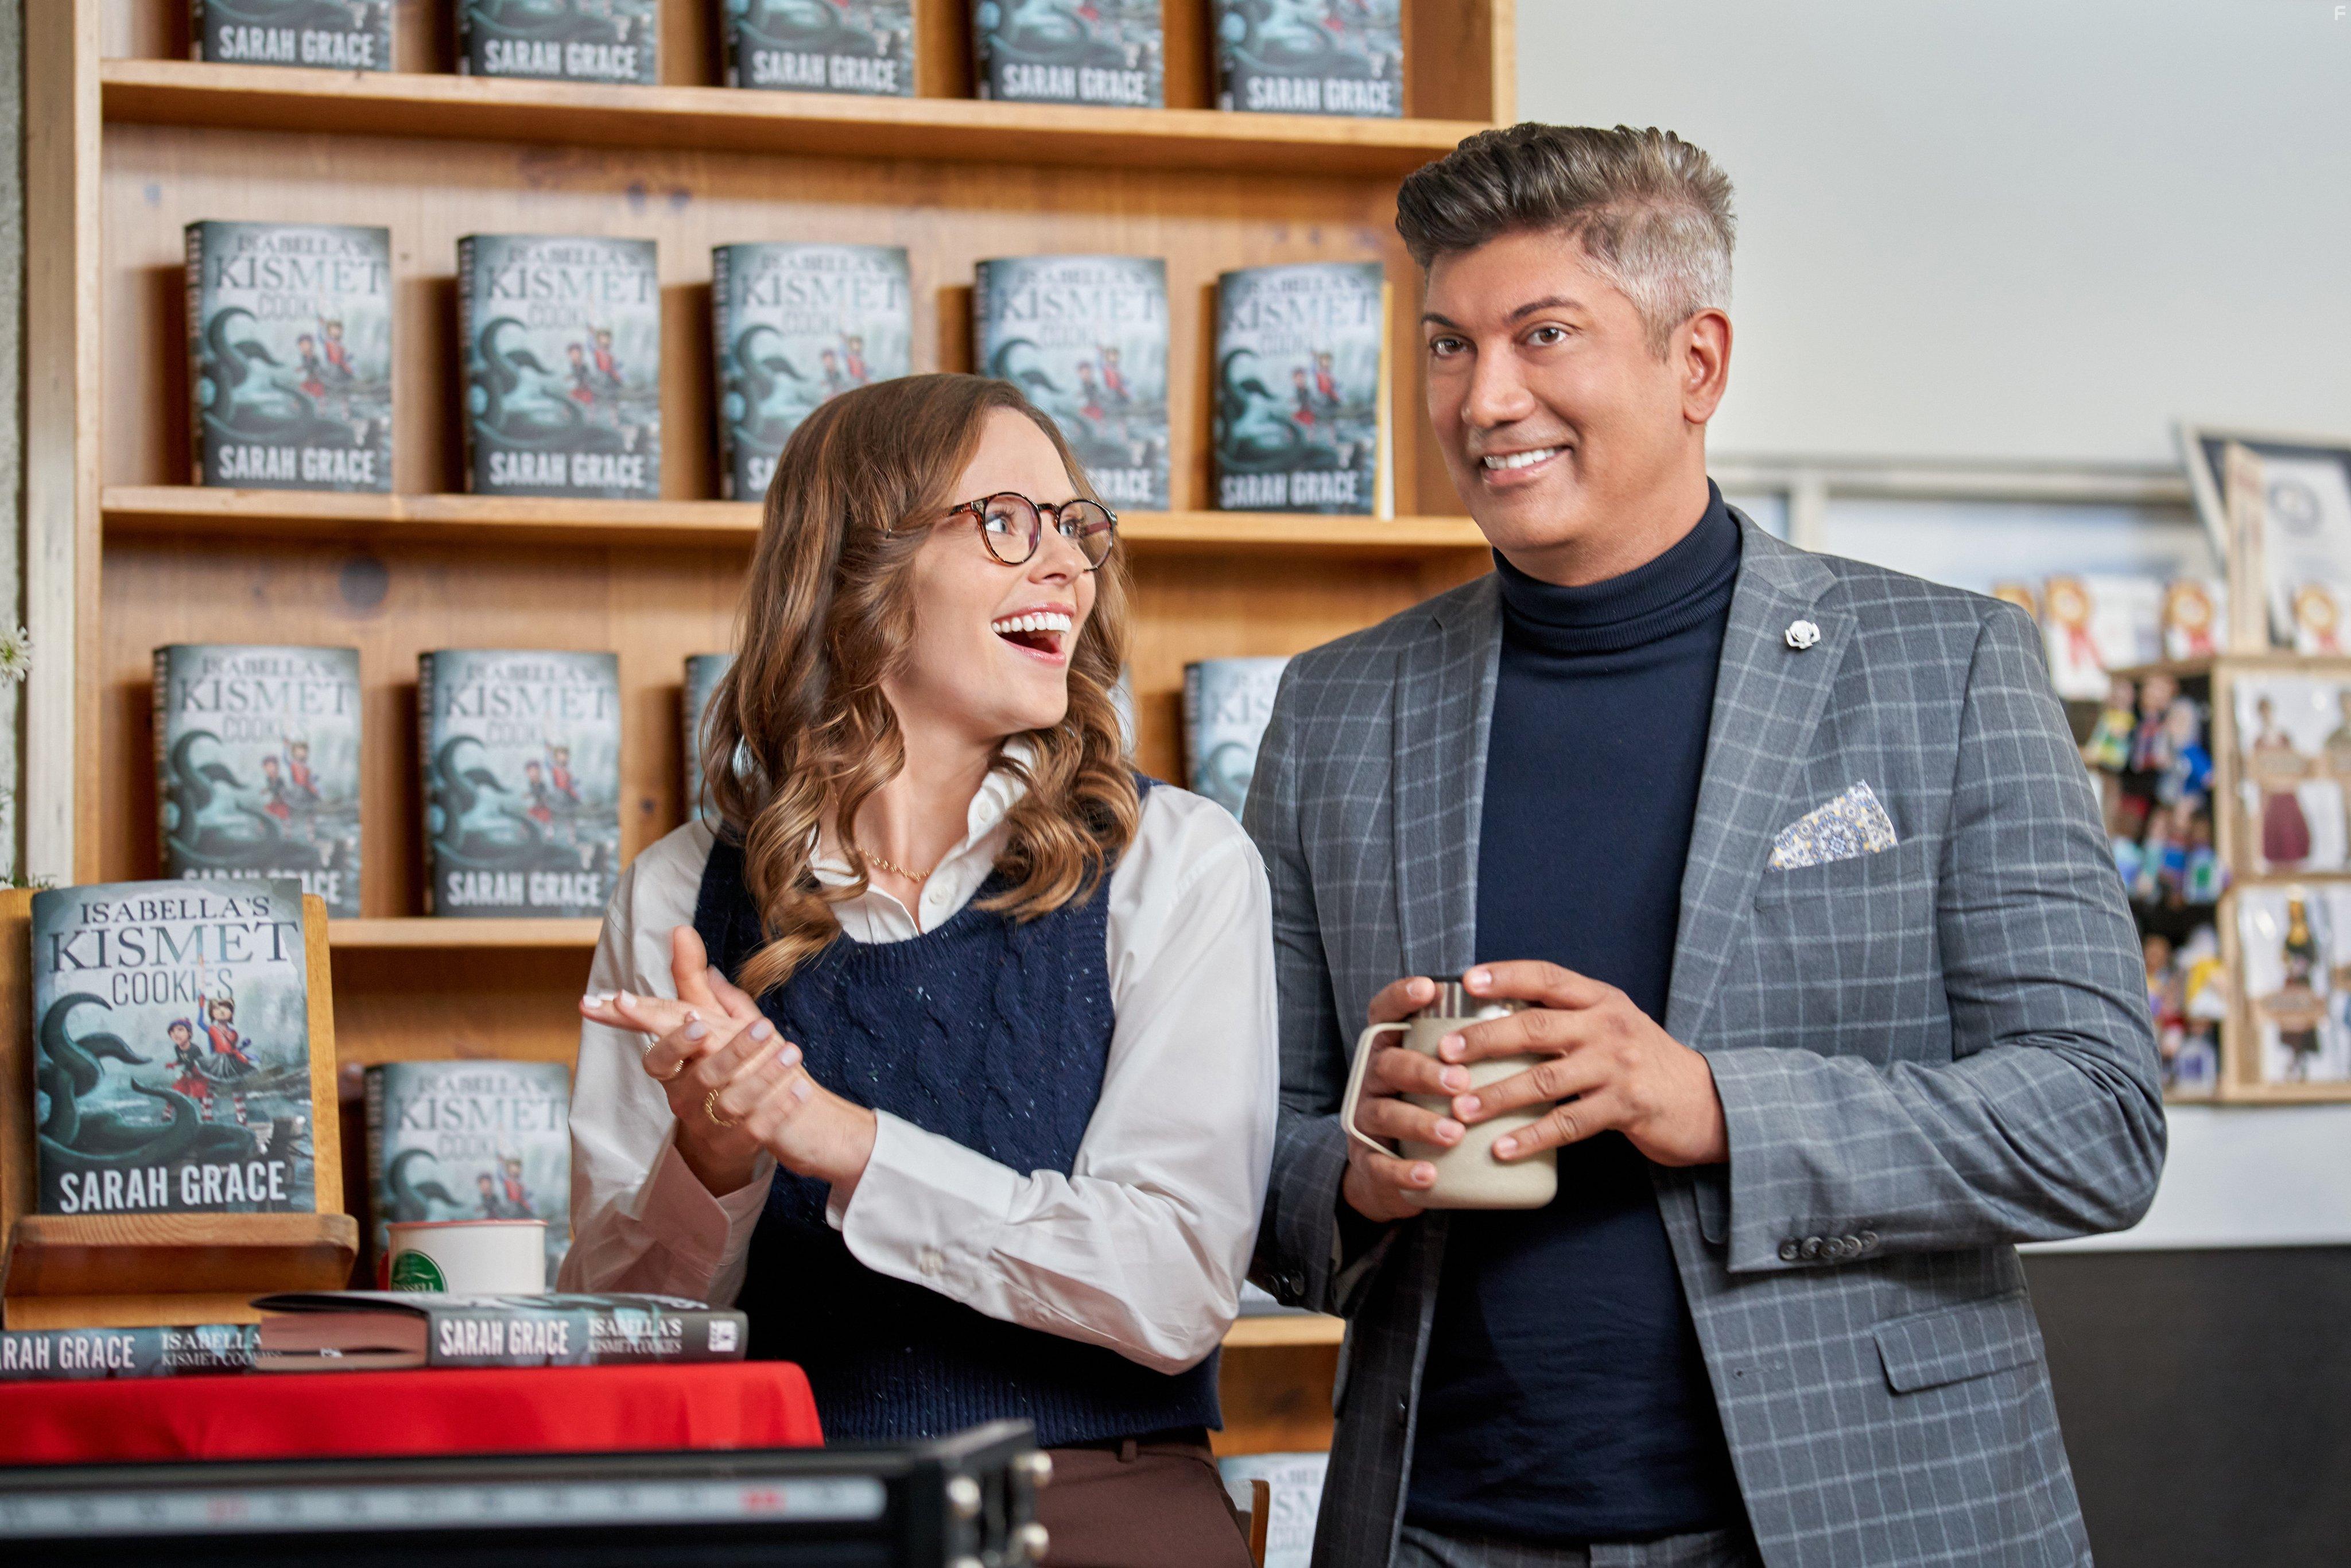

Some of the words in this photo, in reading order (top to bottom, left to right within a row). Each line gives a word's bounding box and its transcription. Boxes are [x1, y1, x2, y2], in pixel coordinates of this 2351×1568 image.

[219, 25, 295, 61] SARAH
[301, 30, 374, 68] GRACE
[486, 40, 561, 76] SARAH
[567, 44, 639, 79] GRACE
[753, 51, 826, 86] SARAH
[831, 57, 899, 92] GRACE
[1003, 64, 1075, 100] SARAH
[1079, 69, 1149, 104] GRACE
[1247, 76, 1319, 111] SARAH
[1323, 79, 1394, 114] GRACE
[215, 254, 389, 294] KISMET
[487, 265, 655, 303] KISMET
[739, 272, 908, 310] KISMET
[999, 285, 1165, 320] KISMET
[219, 445, 296, 479] SARAH
[301, 448, 377, 483] GRACE
[490, 451, 567, 485] SARAH
[571, 453, 645, 488] GRACE
[1220, 473, 1286, 509] SARAH
[1290, 469, 1358, 504] GRACE
[180, 678, 352, 716] KISMET
[445, 681, 618, 719] KISMET
[447, 871, 525, 906] SARAH
[529, 872, 602, 907] GRACE
[81, 897, 269, 924] ISABELLA'S
[50, 921, 297, 972] KISMET
[113, 968, 233, 1005] COOKIES
[396, 1095, 569, 1132] KISMET
[60, 1167, 168, 1214] SARAH
[181, 1161, 287, 1206] GRACE
[0, 1336, 50, 1370] RAH
[59, 1335, 135, 1369] GRACE
[440, 1319, 503, 1356] SARAH
[509, 1319, 569, 1355] GRACE
[161, 1352, 219, 1367] KISMET
